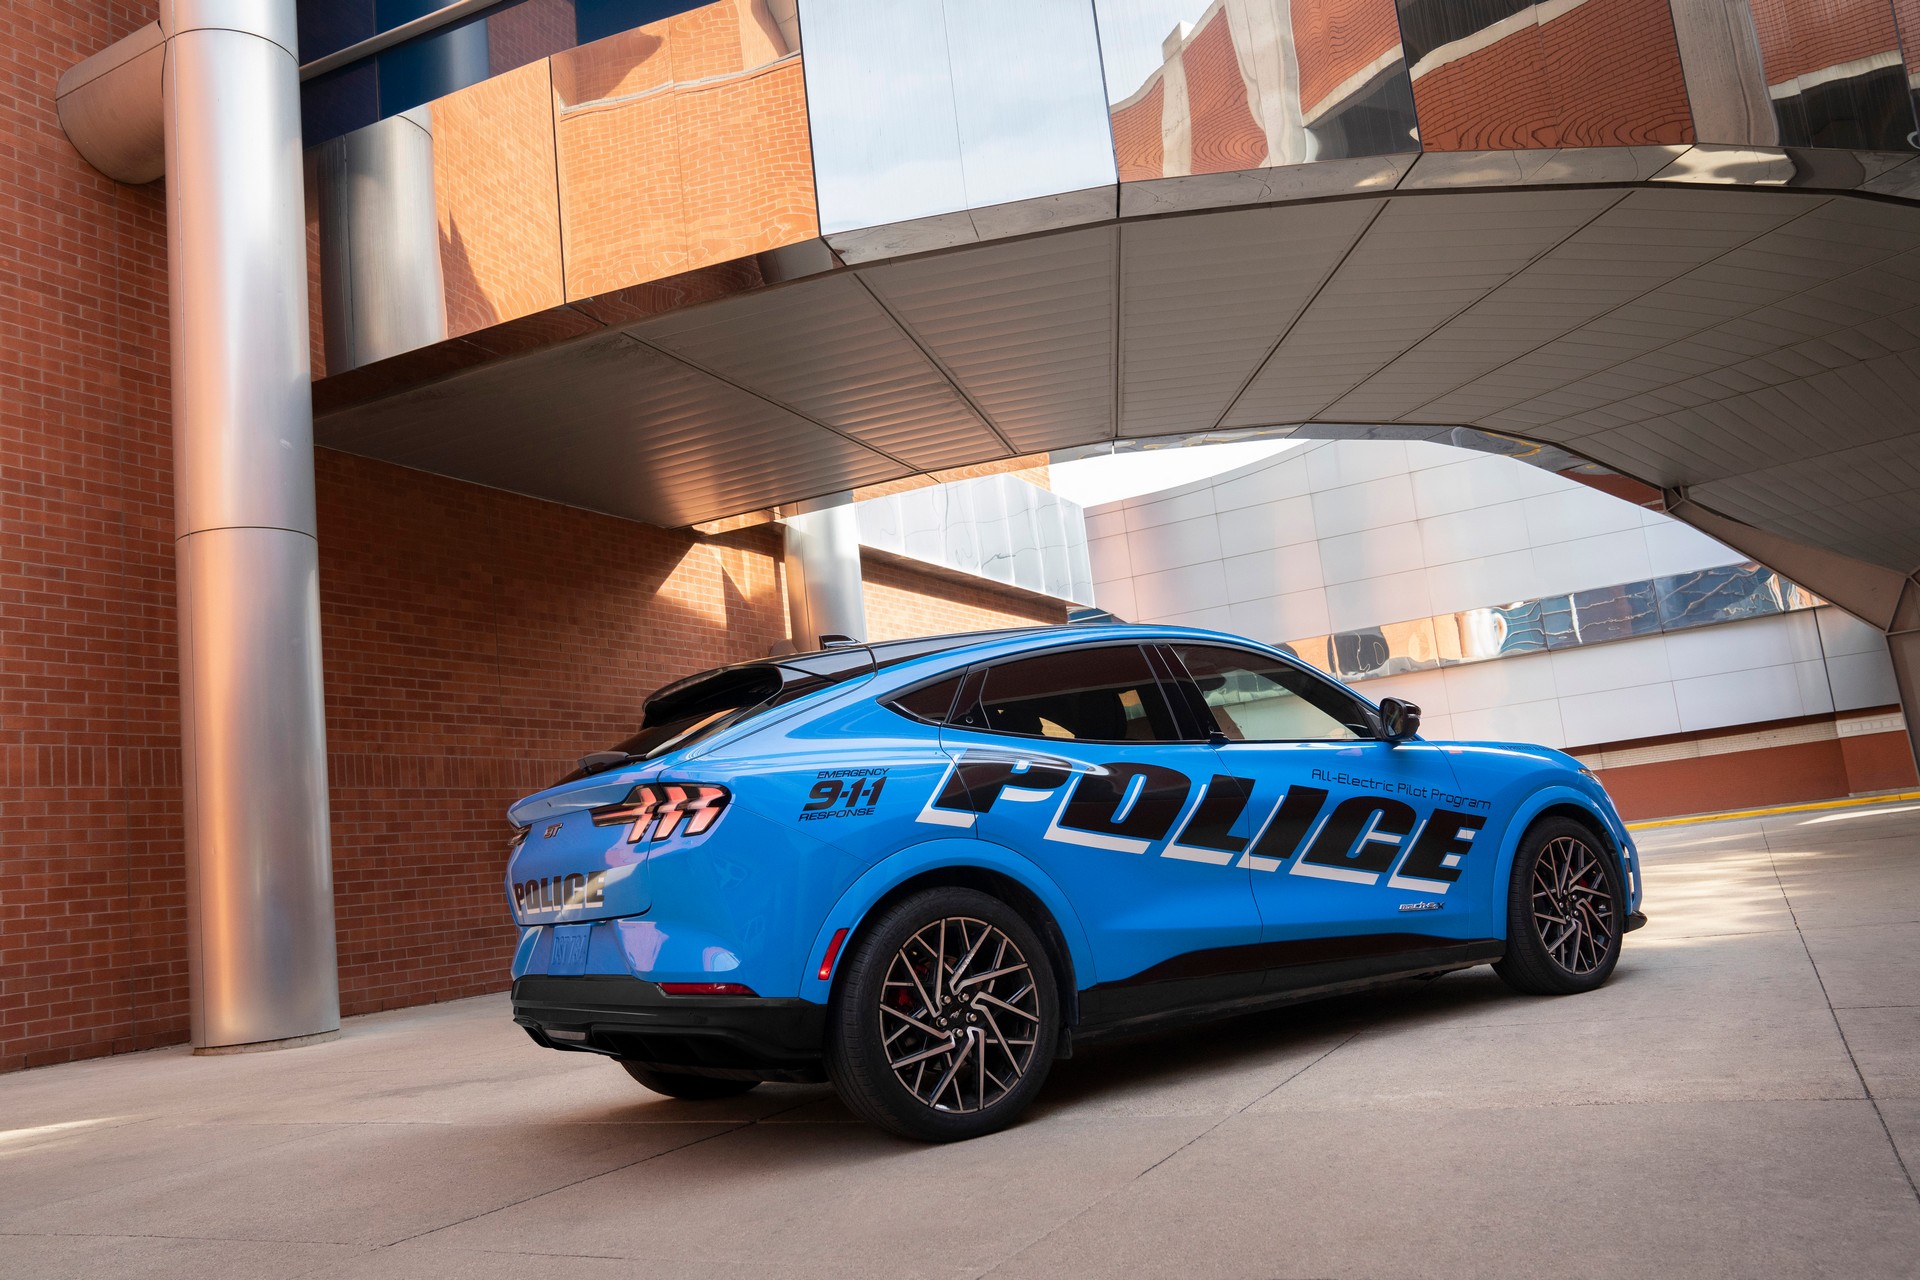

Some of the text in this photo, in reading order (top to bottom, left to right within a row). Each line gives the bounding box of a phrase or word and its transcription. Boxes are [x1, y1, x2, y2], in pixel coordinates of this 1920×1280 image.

[817, 768, 890, 779] EMERGENCY
[1311, 768, 1492, 810] All-Electric Pilot Program
[798, 807, 876, 822] RESPONSE
[915, 748, 1488, 895] POLICE
[544, 823, 563, 839] GT
[513, 869, 607, 916] POLICE
